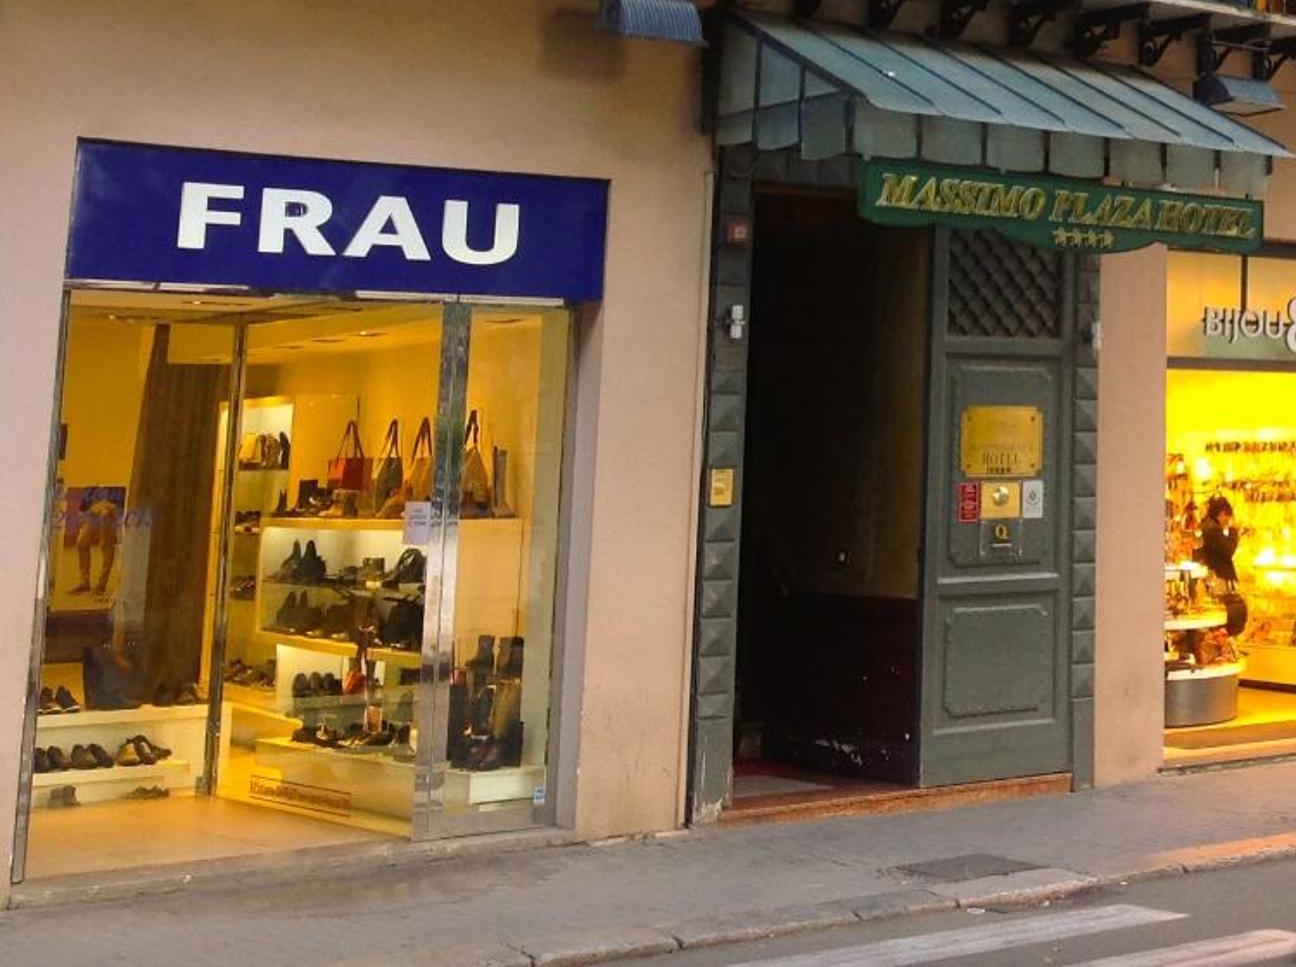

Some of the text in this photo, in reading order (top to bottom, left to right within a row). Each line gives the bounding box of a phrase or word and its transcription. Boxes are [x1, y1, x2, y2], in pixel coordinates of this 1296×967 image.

[177, 181, 520, 265] FRAU
[875, 172, 1257, 240] MASSIMO PLAZA HOTEL
[1203, 306, 1284, 343] BIJOU
